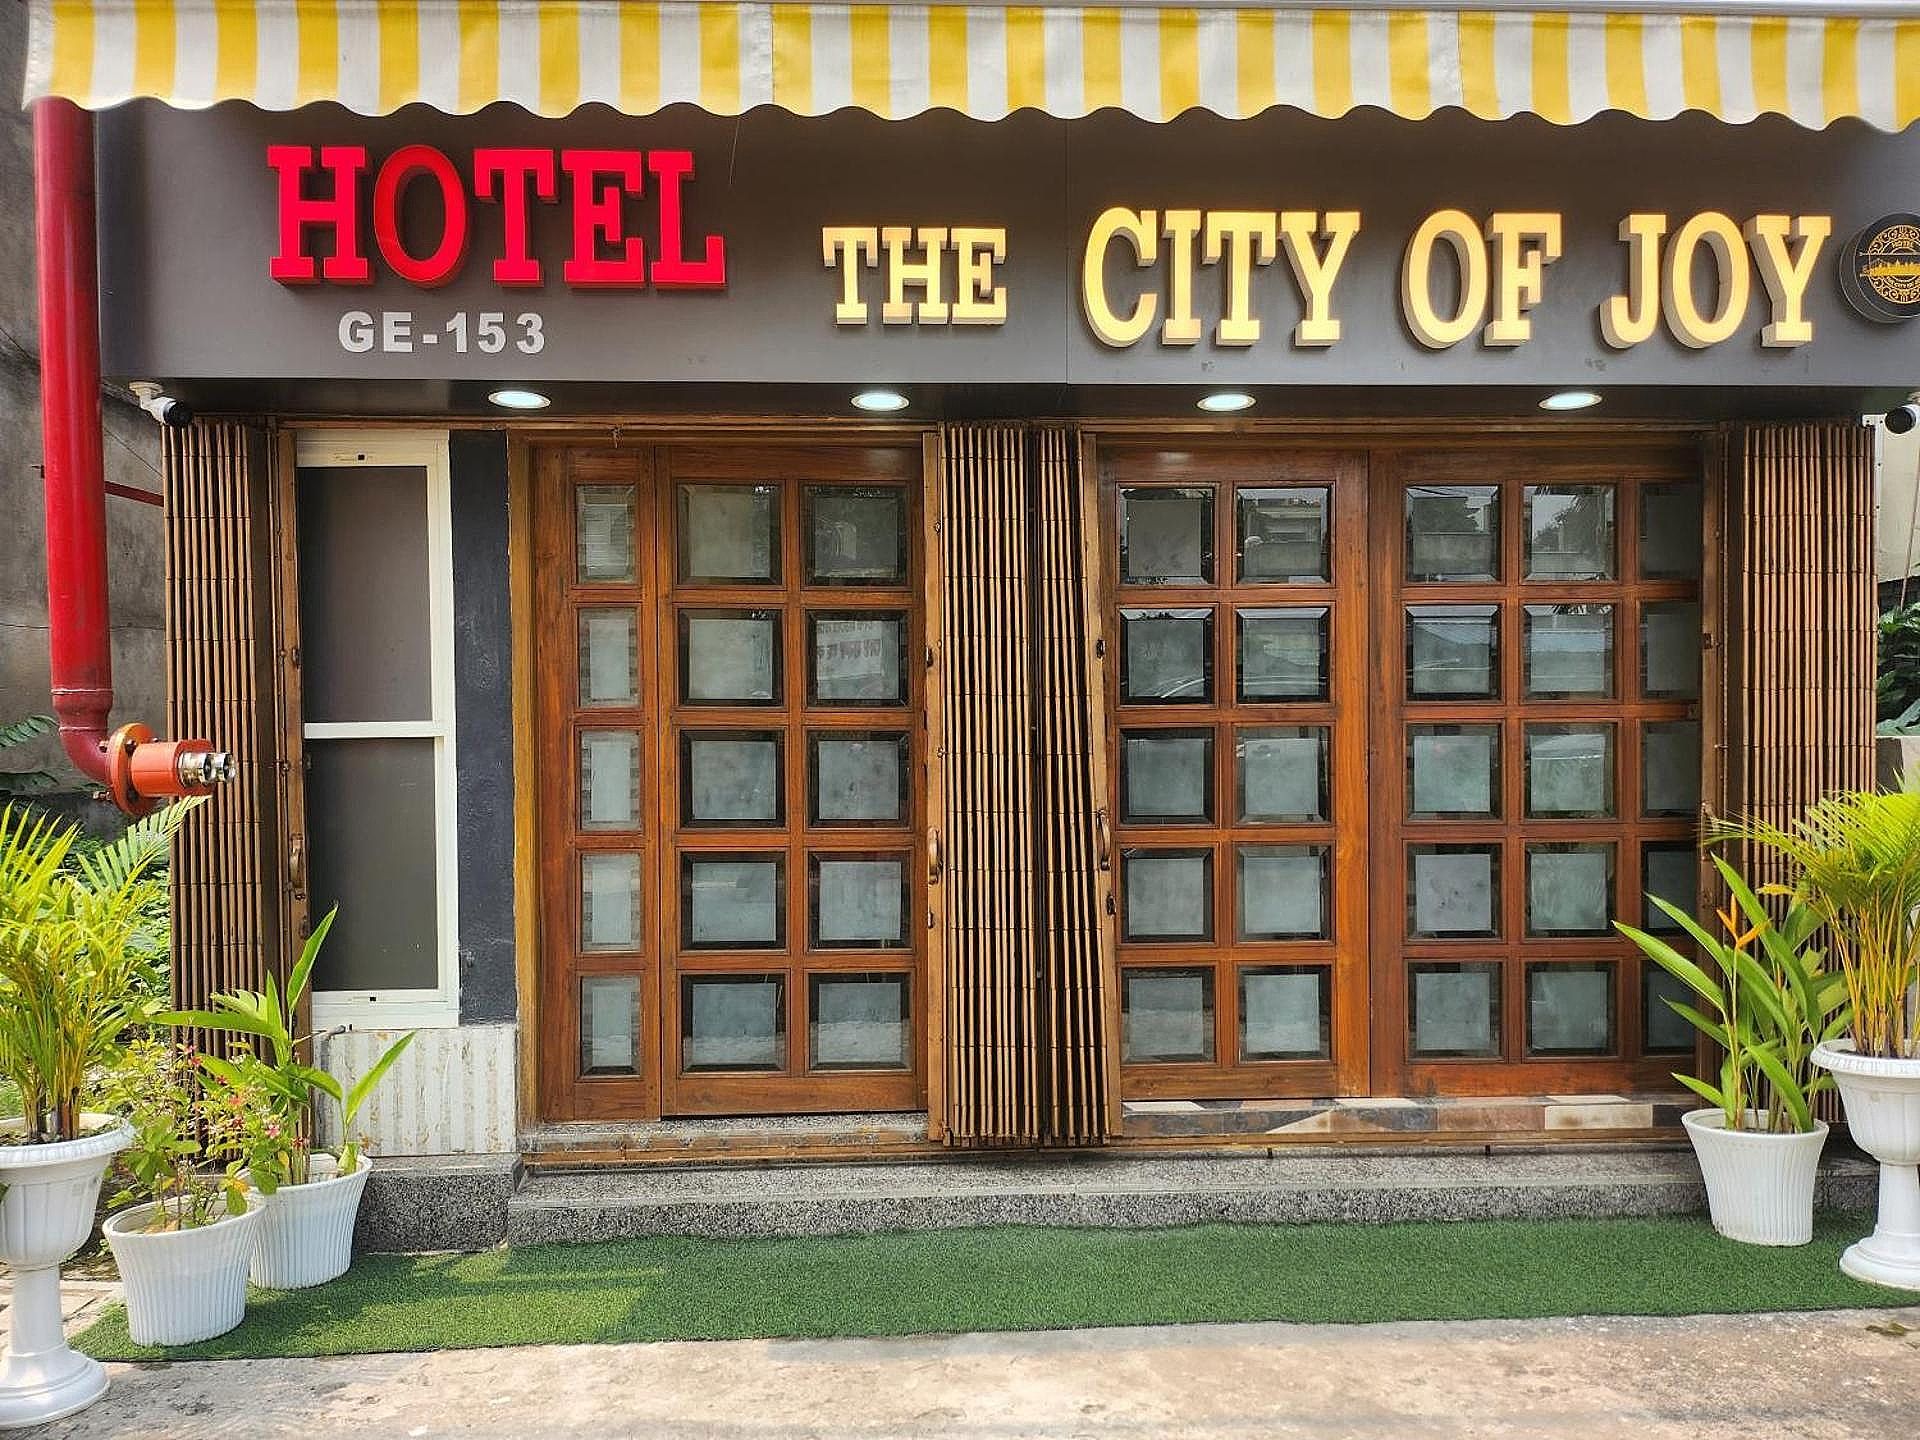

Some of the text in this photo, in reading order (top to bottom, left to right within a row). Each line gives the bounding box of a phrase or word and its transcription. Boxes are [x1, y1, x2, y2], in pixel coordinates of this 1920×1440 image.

[267, 144, 1832, 349] HOTEL THE CITY OF JOY
[338, 311, 545, 354] GE-153
